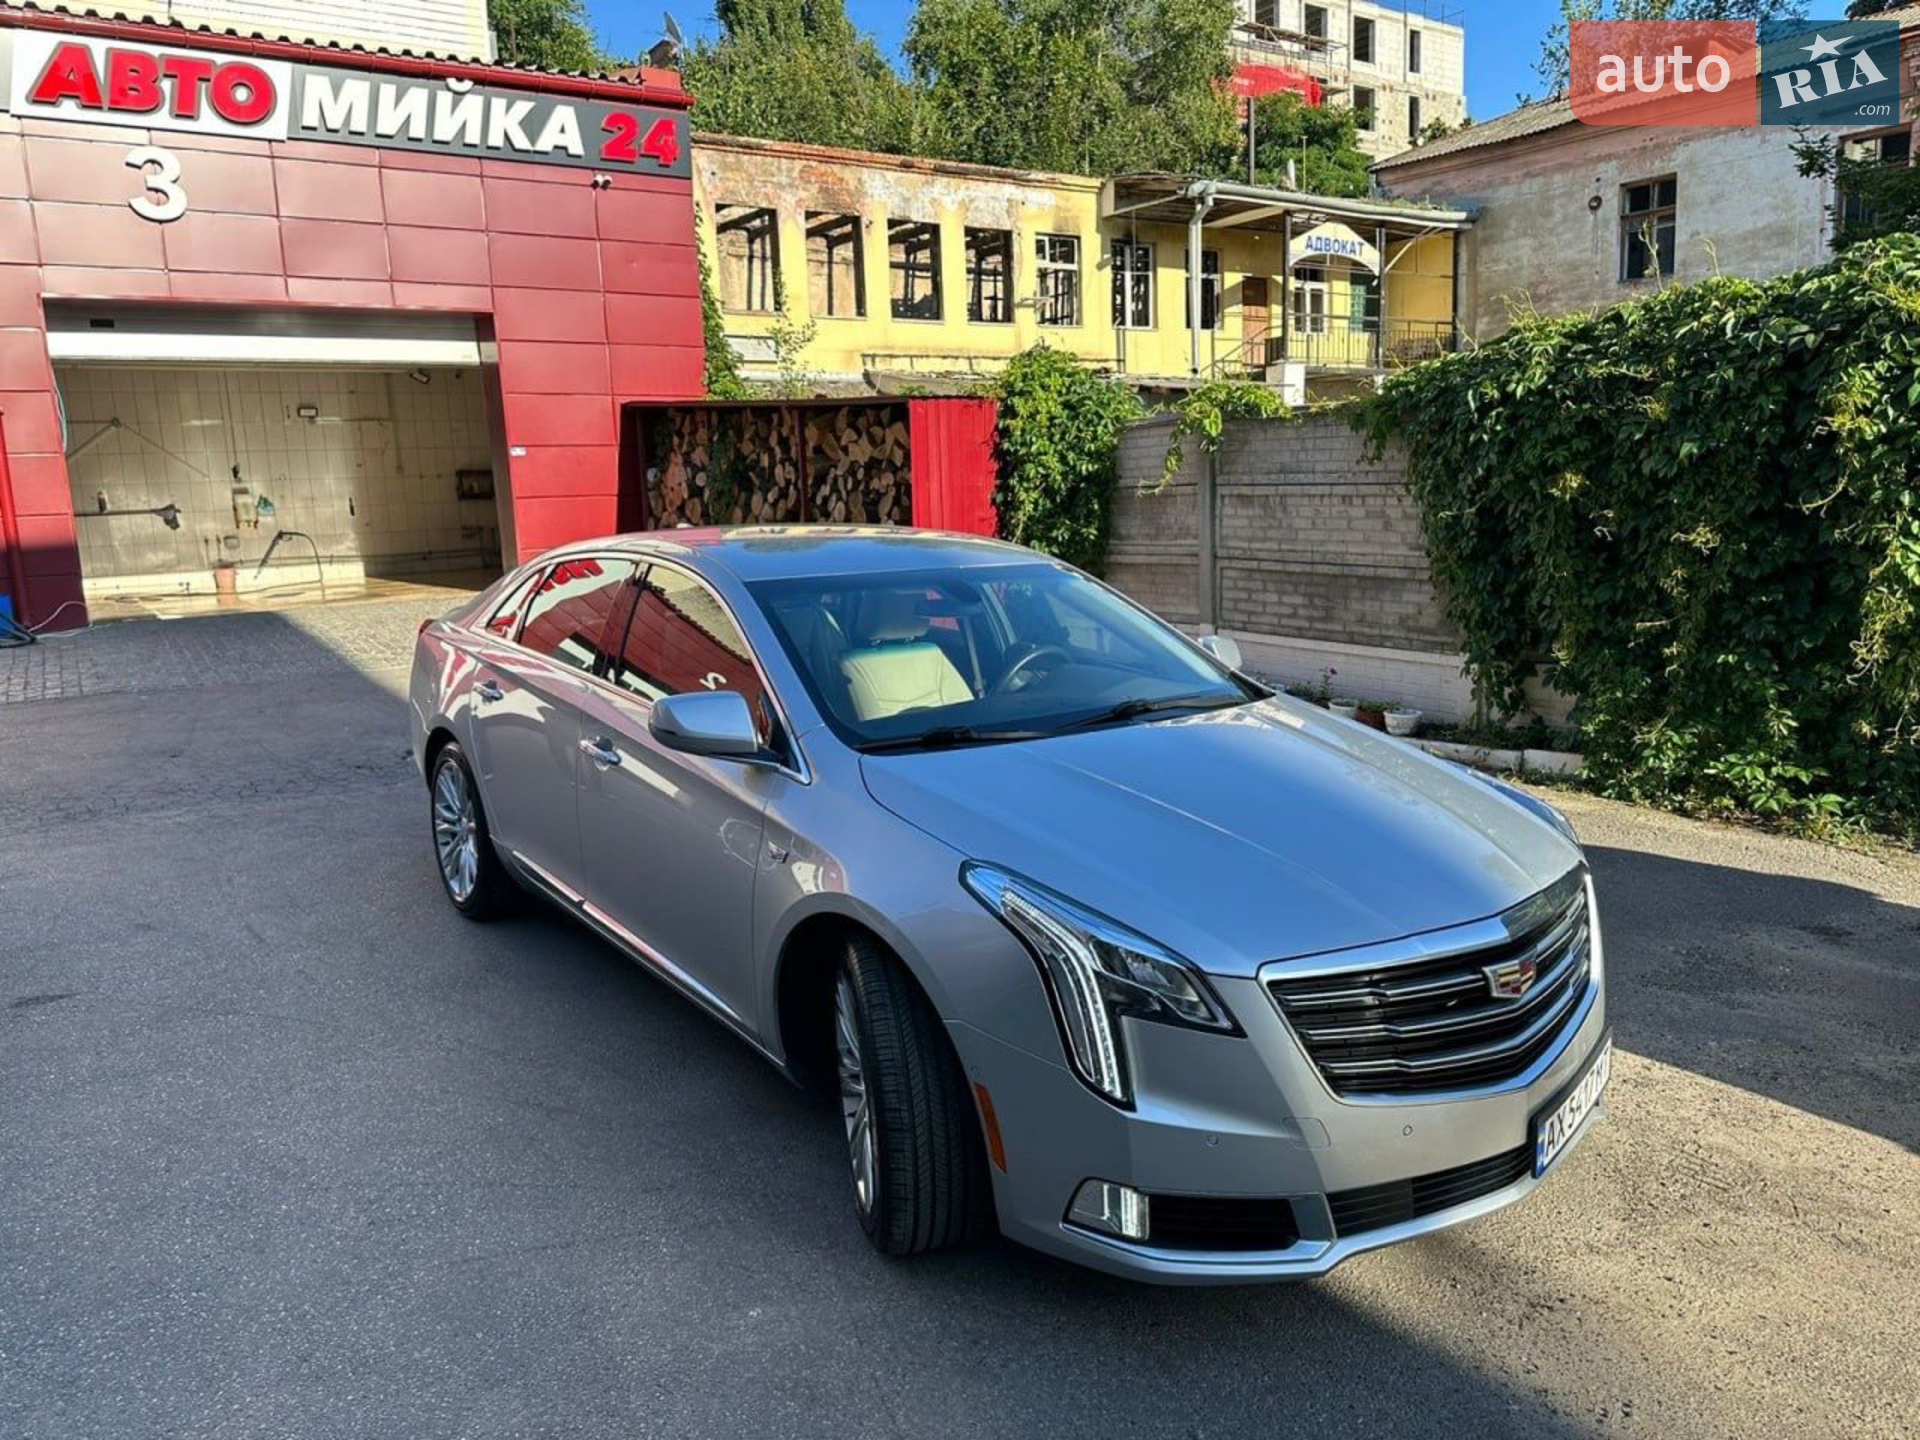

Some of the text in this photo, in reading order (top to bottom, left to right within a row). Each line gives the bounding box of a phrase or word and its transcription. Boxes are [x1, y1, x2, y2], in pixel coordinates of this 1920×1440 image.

[26, 41, 680, 167] АВТО МИЙКА 24
[124, 145, 188, 223] 3
[1305, 235, 1365, 256] АДВОКАТ
